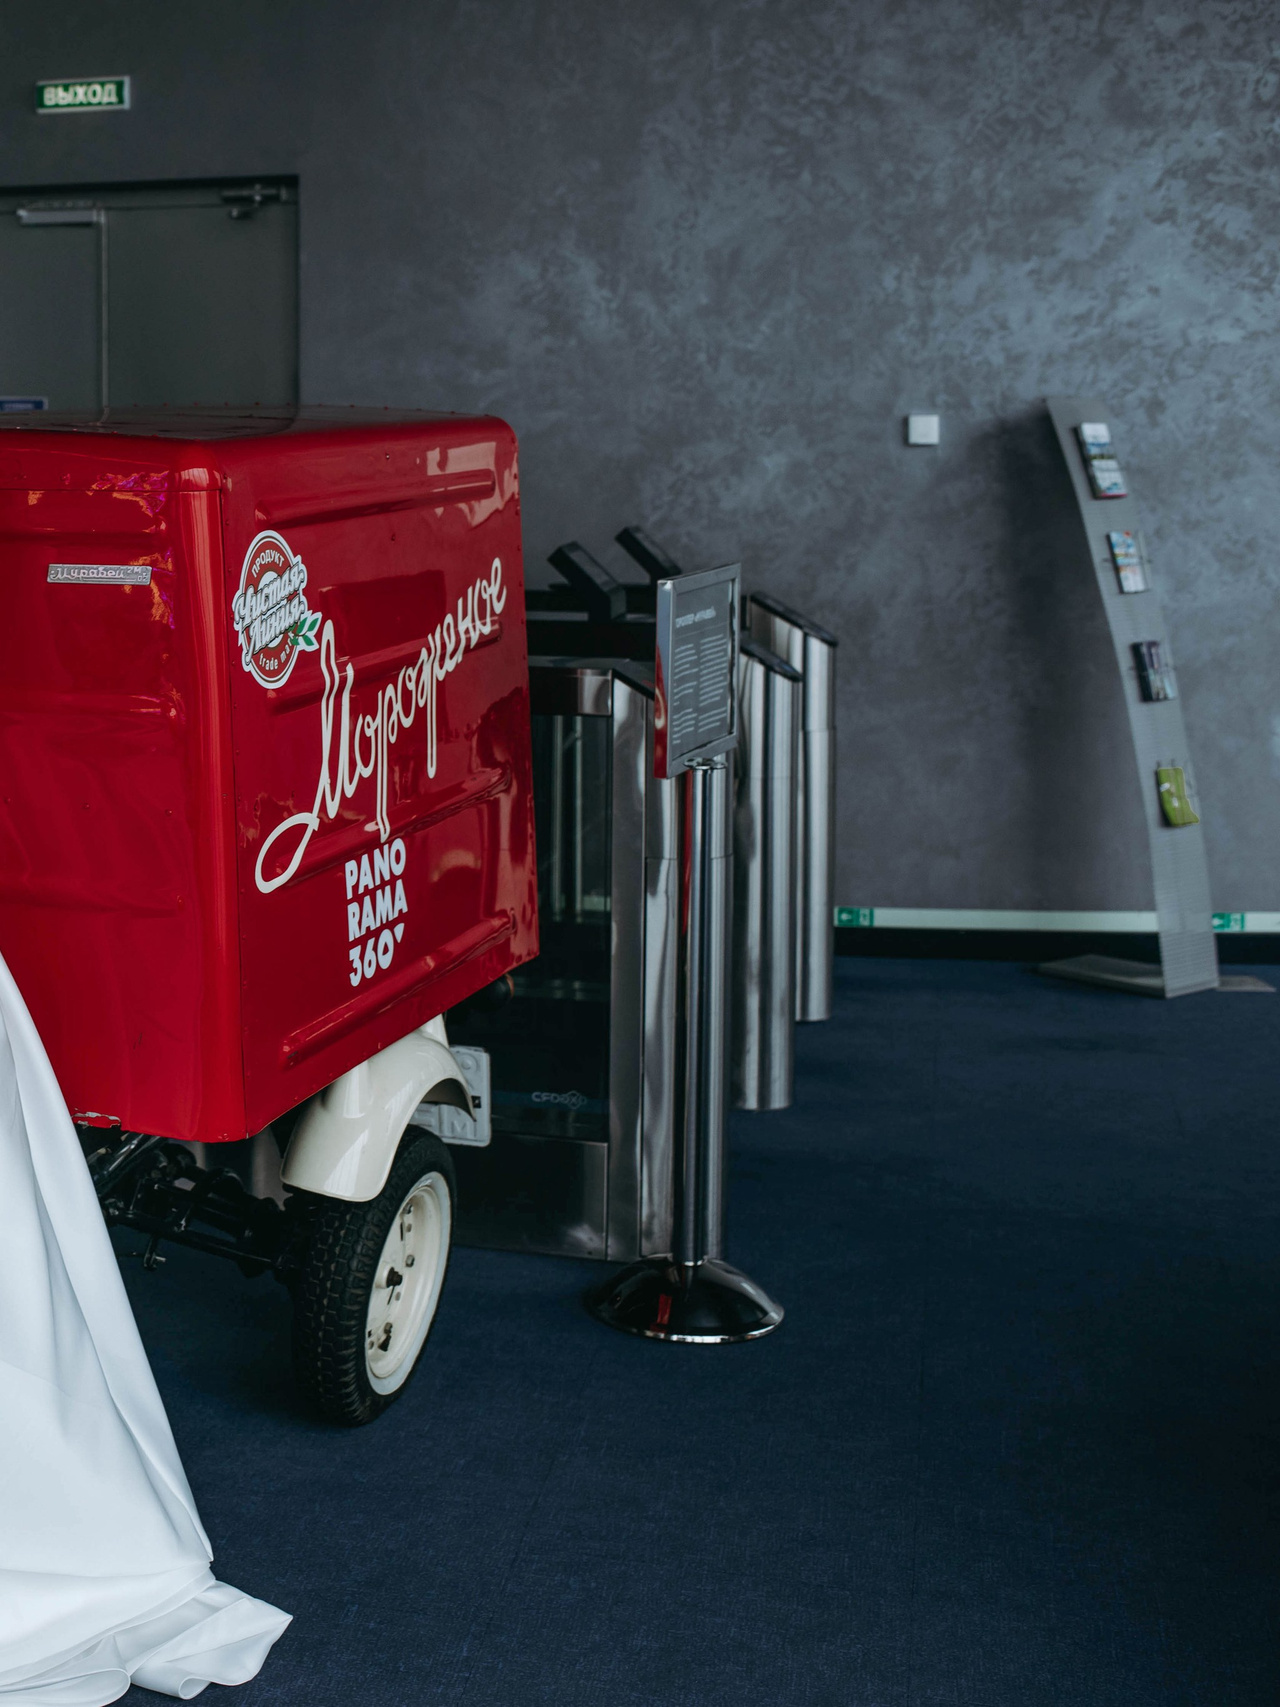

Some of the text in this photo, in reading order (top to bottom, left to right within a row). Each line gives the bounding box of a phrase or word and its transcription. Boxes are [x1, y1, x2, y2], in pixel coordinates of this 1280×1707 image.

[43, 83, 119, 106] ВЫХОД
[234, 561, 305, 628] Чистая
[251, 549, 285, 578] ПРОДУКТ
[244, 597, 305, 665] Линия
[259, 653, 279, 670] trade
[254, 557, 508, 894] Мороженое
[345, 838, 406, 900] PANO
[347, 879, 408, 942] RAMA
